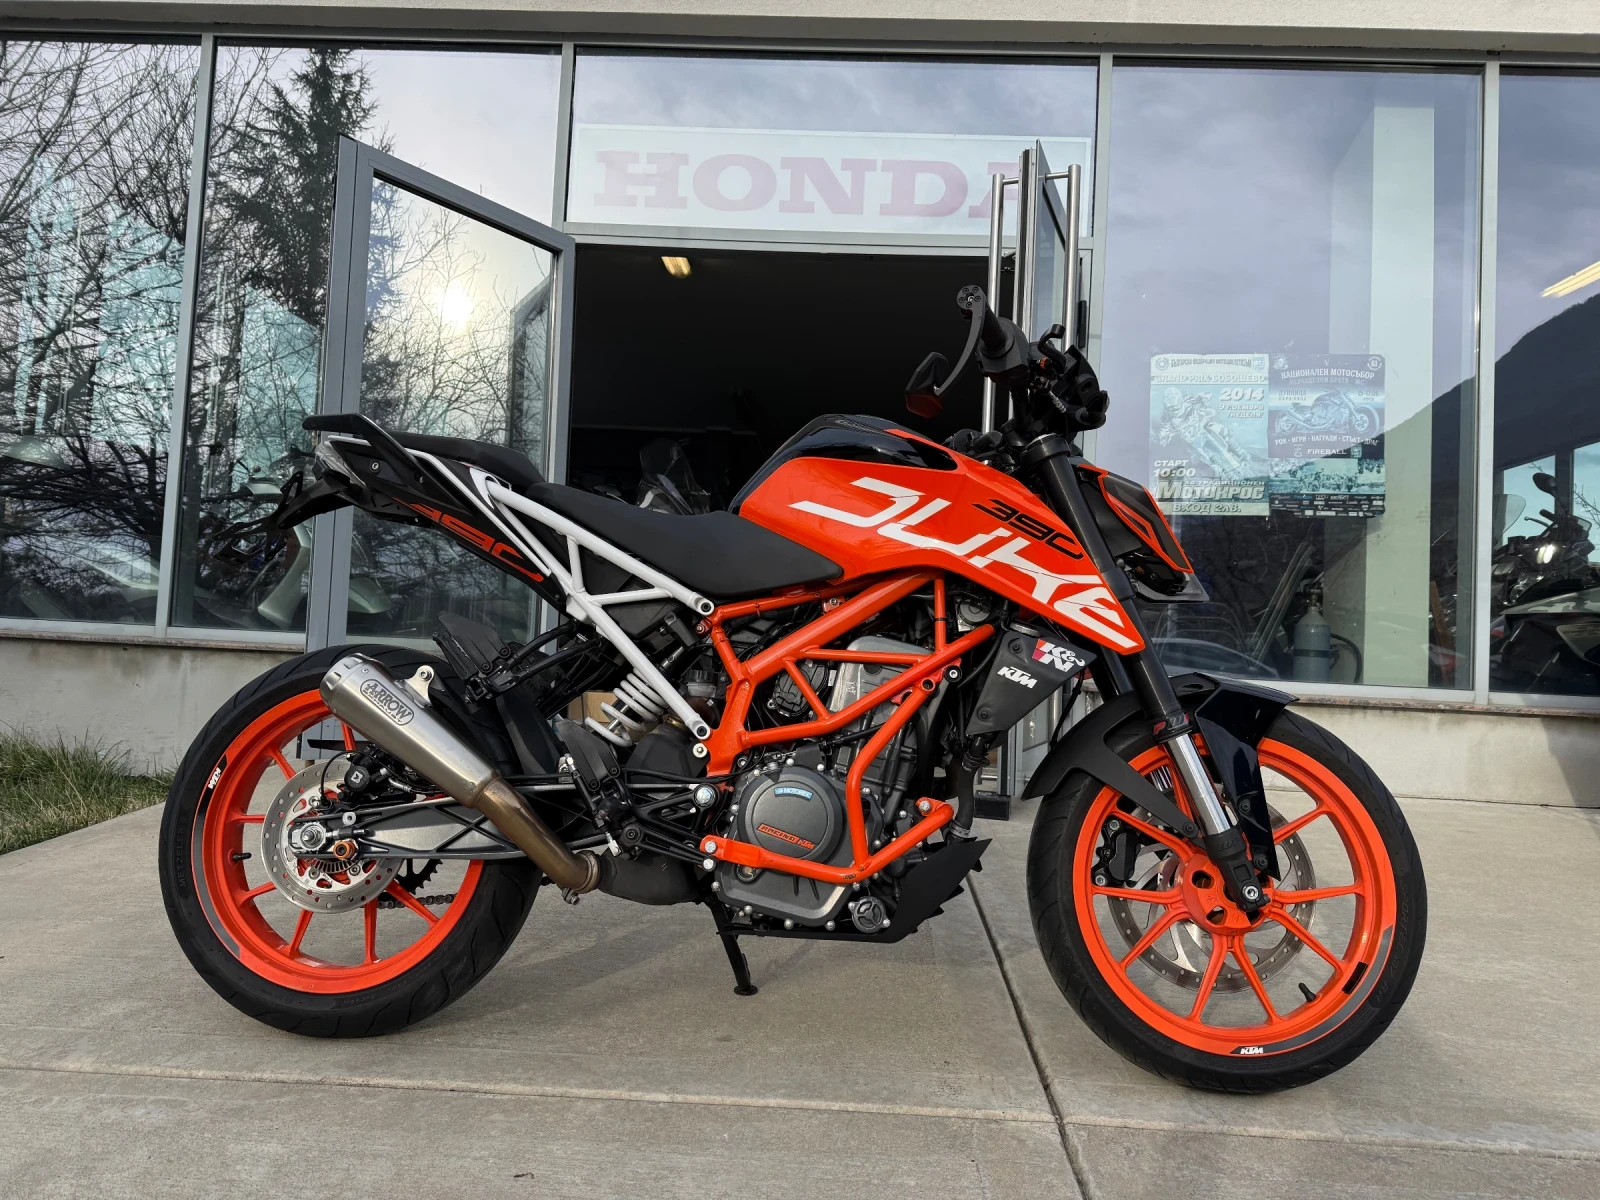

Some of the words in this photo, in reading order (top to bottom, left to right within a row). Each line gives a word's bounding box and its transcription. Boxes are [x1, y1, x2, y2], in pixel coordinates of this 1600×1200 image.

[1155, 374, 1187, 383] GRAND
[1189, 374, 1209, 383] PRIX
[1211, 374, 1265, 383] БОБОШЕВО
[1281, 368, 1329, 379] НАЦИОНАЛЕН
[1330, 368, 1375, 379] МОТОСЪБОР
[1220, 387, 1265, 401] 2014
[1219, 403, 1226, 411] 9
[1153, 459, 1189, 467] СТАРТ
[1153, 468, 1196, 477] 10:00
[1172, 503, 1211, 514] ВХОД
[1034, 639, 1086, 673] K&N
[997, 666, 1038, 689] KTM
[364, 682, 412, 720] ARROW
[207, 767, 222, 789] KTM
[761, 826, 796, 842] RACING
[1240, 1045, 1264, 1055] KTM
